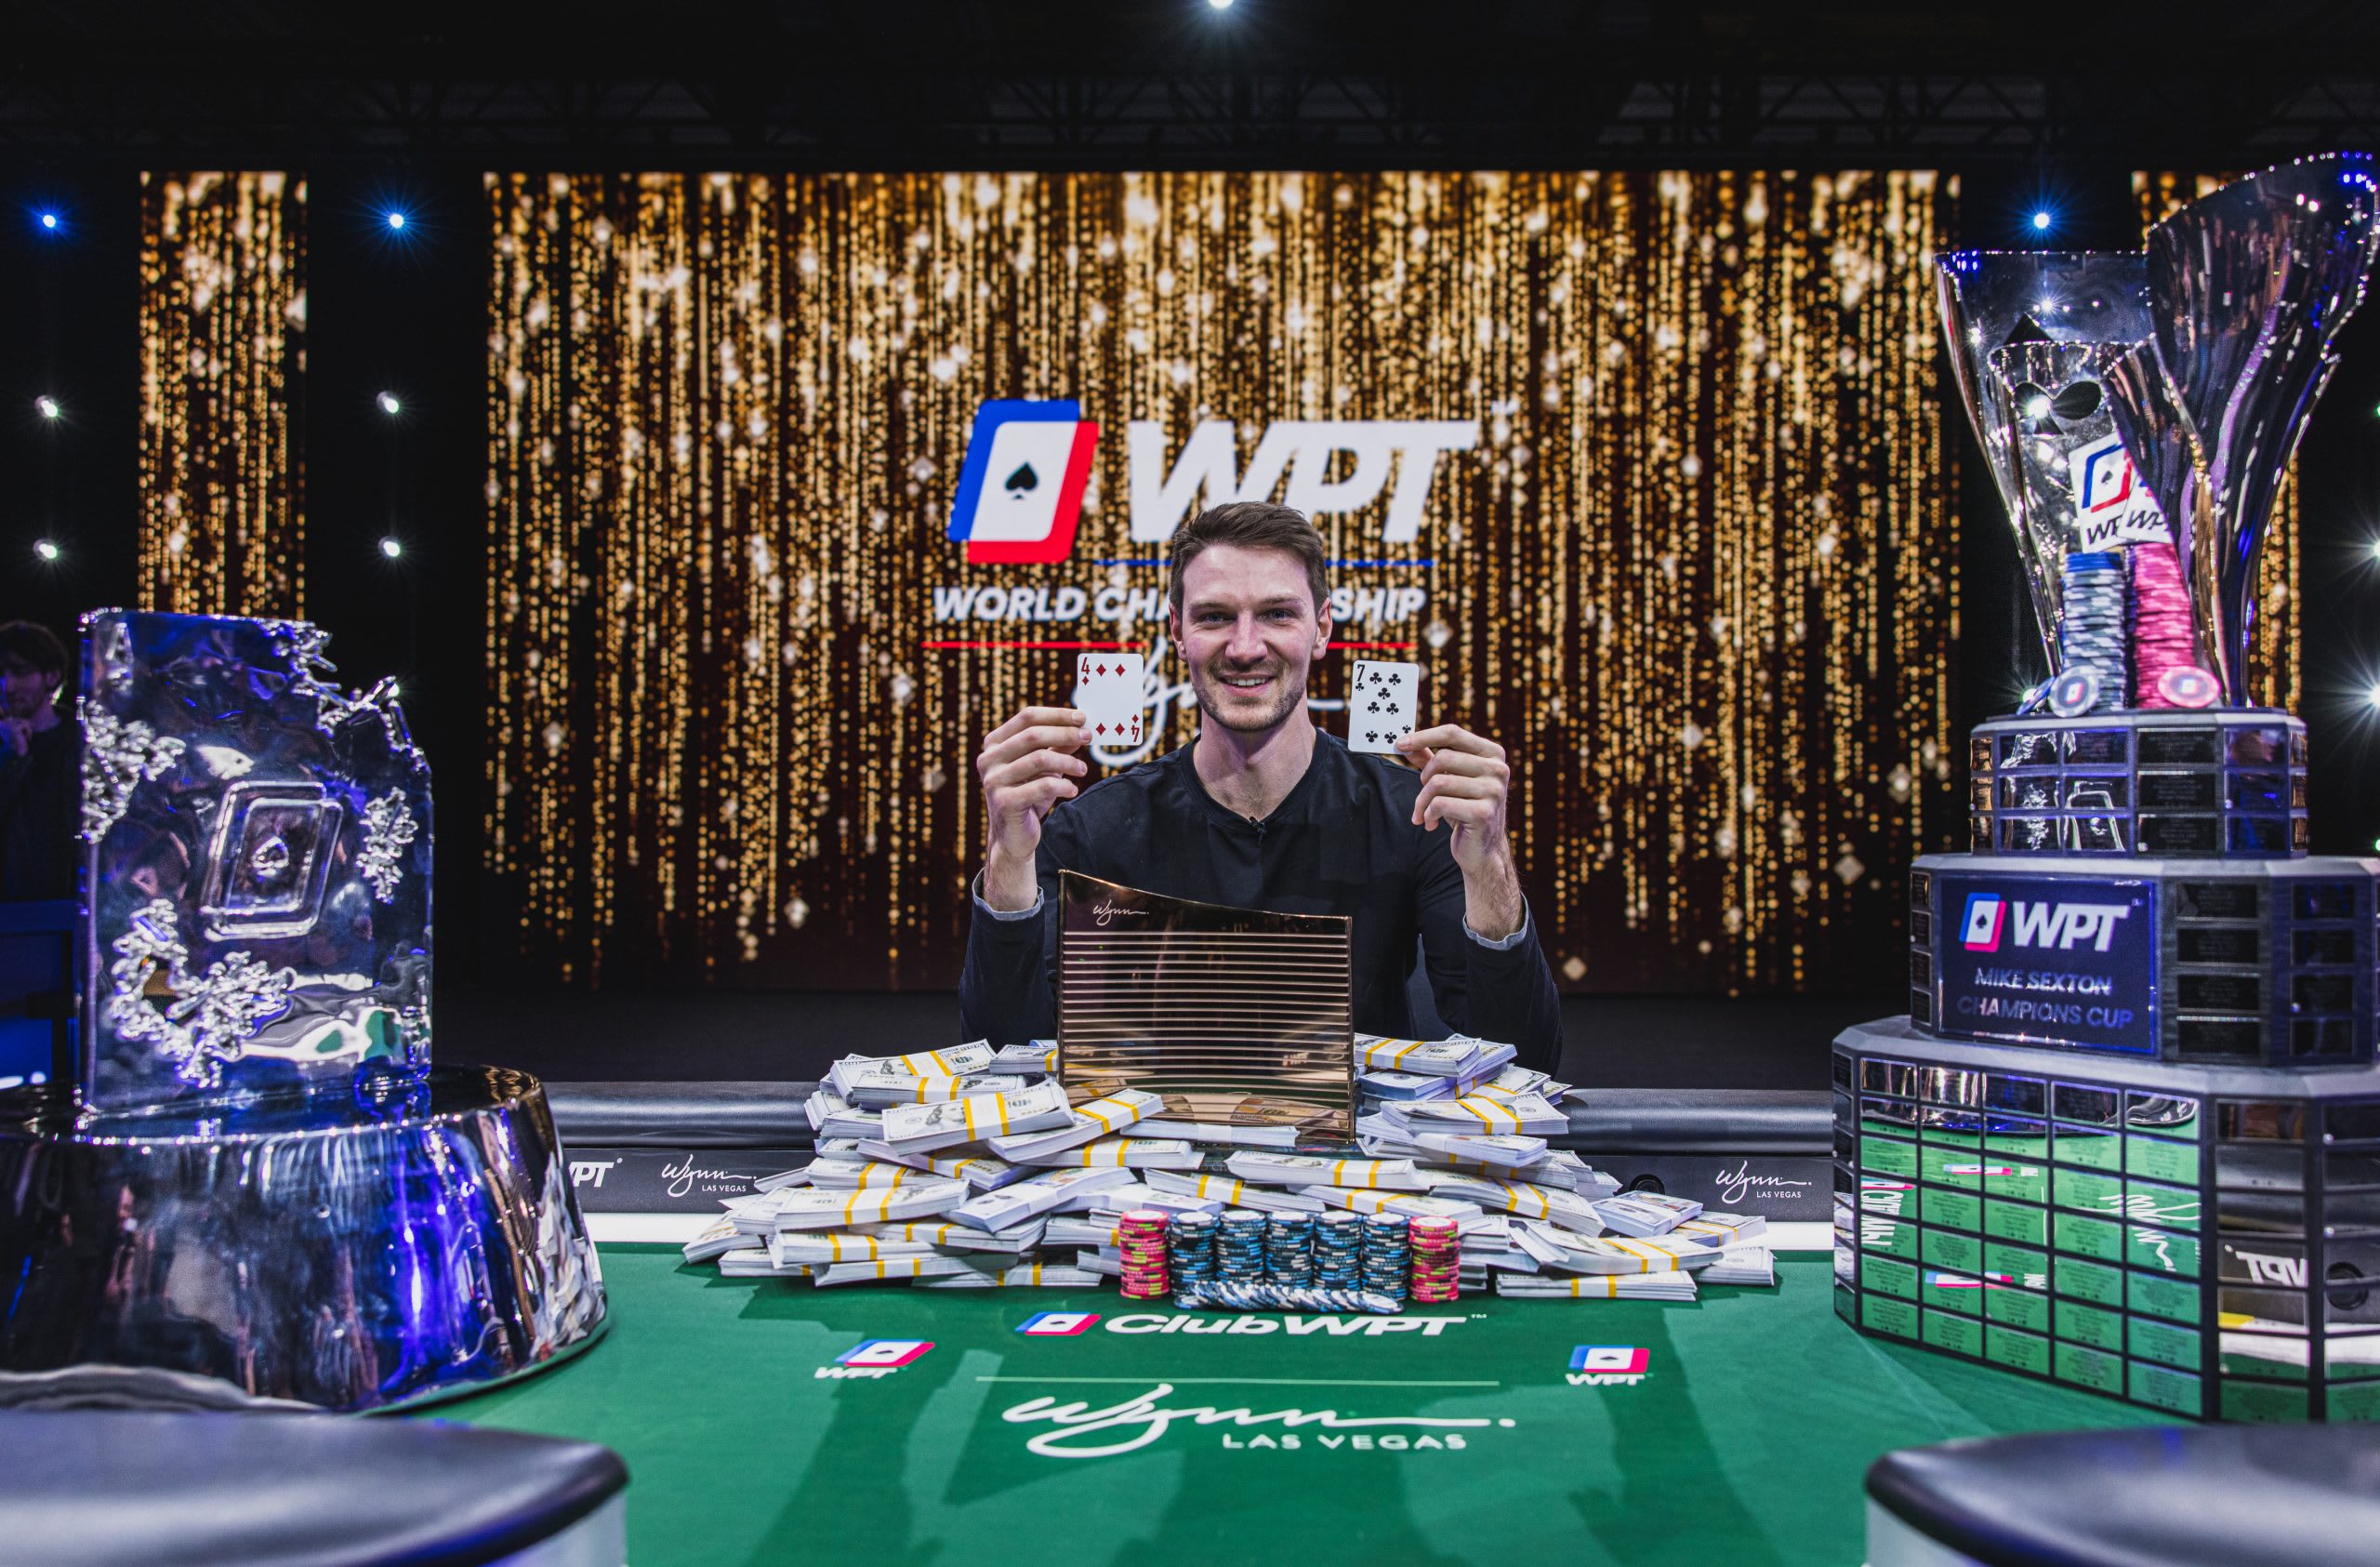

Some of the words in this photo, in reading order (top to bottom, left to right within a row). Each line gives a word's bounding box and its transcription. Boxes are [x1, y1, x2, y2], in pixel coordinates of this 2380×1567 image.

[1128, 420, 1480, 543] WPT
[932, 587, 1087, 621] WORLD
[1093, 587, 1427, 622] CHSHIP
[1081, 657, 1091, 675] 4
[1357, 664, 1368, 683] 7
[2012, 900, 2131, 952] WPT
[1975, 967, 2023, 991] MIKE
[2027, 970, 2111, 996] SEXTON
[1956, 995, 2082, 1025] CHAMPIONS
[2085, 1006, 2135, 1029] CUP
[568, 1161, 615, 1188] PT
[1756, 1190, 1772, 1199] LAS
[1774, 1190, 1802, 1199] VEGAS
[1104, 1313, 1468, 1336] ClubWPT
[813, 1367, 898, 1379] WPT
[1565, 1373, 1646, 1386] WPT
[1222, 1434, 1302, 1450] LAS
[1317, 1434, 1468, 1450] VEGAS
